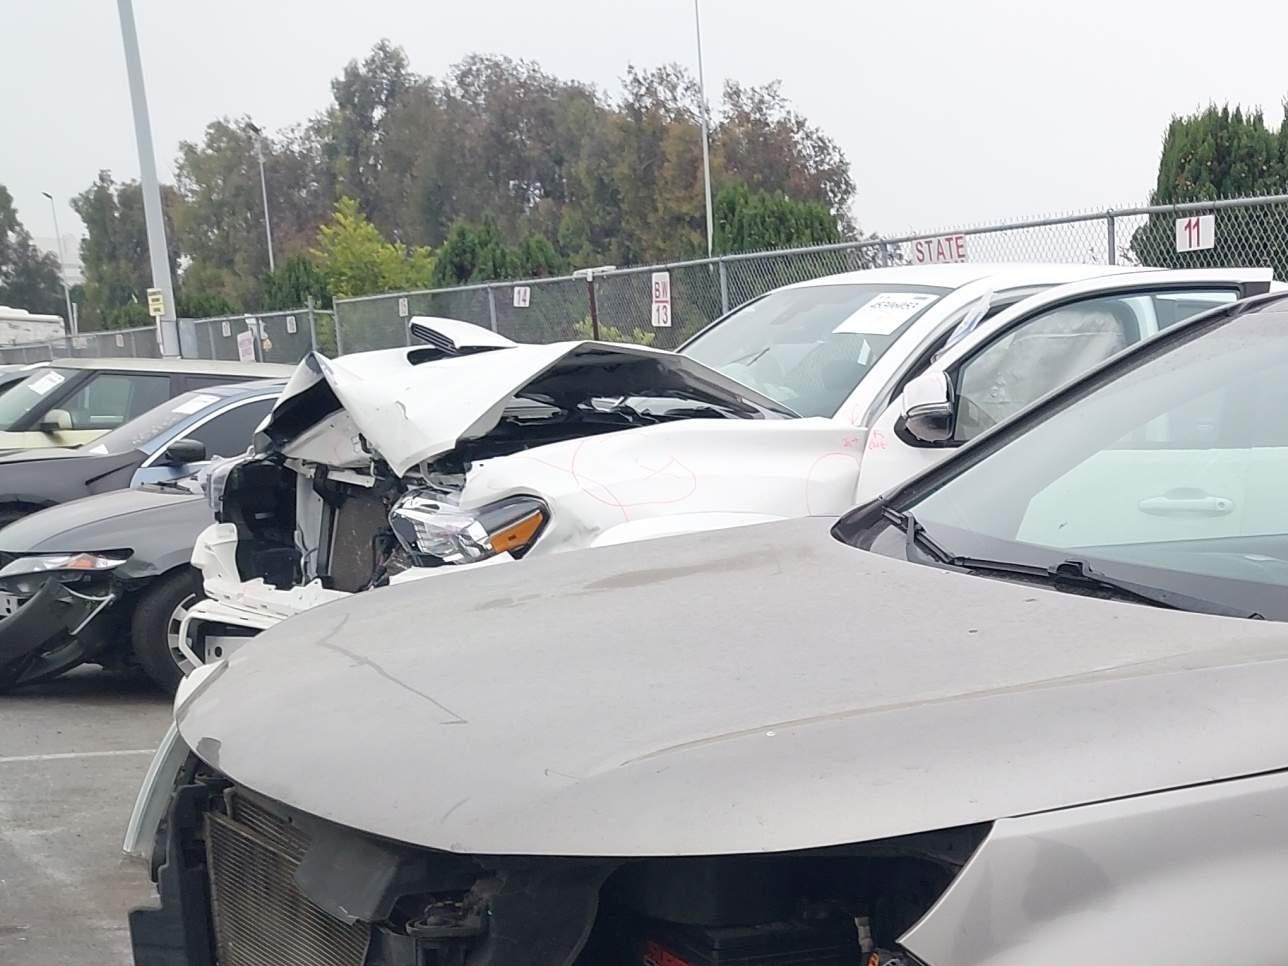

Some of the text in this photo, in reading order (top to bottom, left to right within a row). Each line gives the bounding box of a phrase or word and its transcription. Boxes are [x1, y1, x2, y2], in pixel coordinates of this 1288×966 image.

[1184, 216, 1201, 249] 11
[915, 235, 966, 263] STATE
[655, 304, 669, 325] 13
